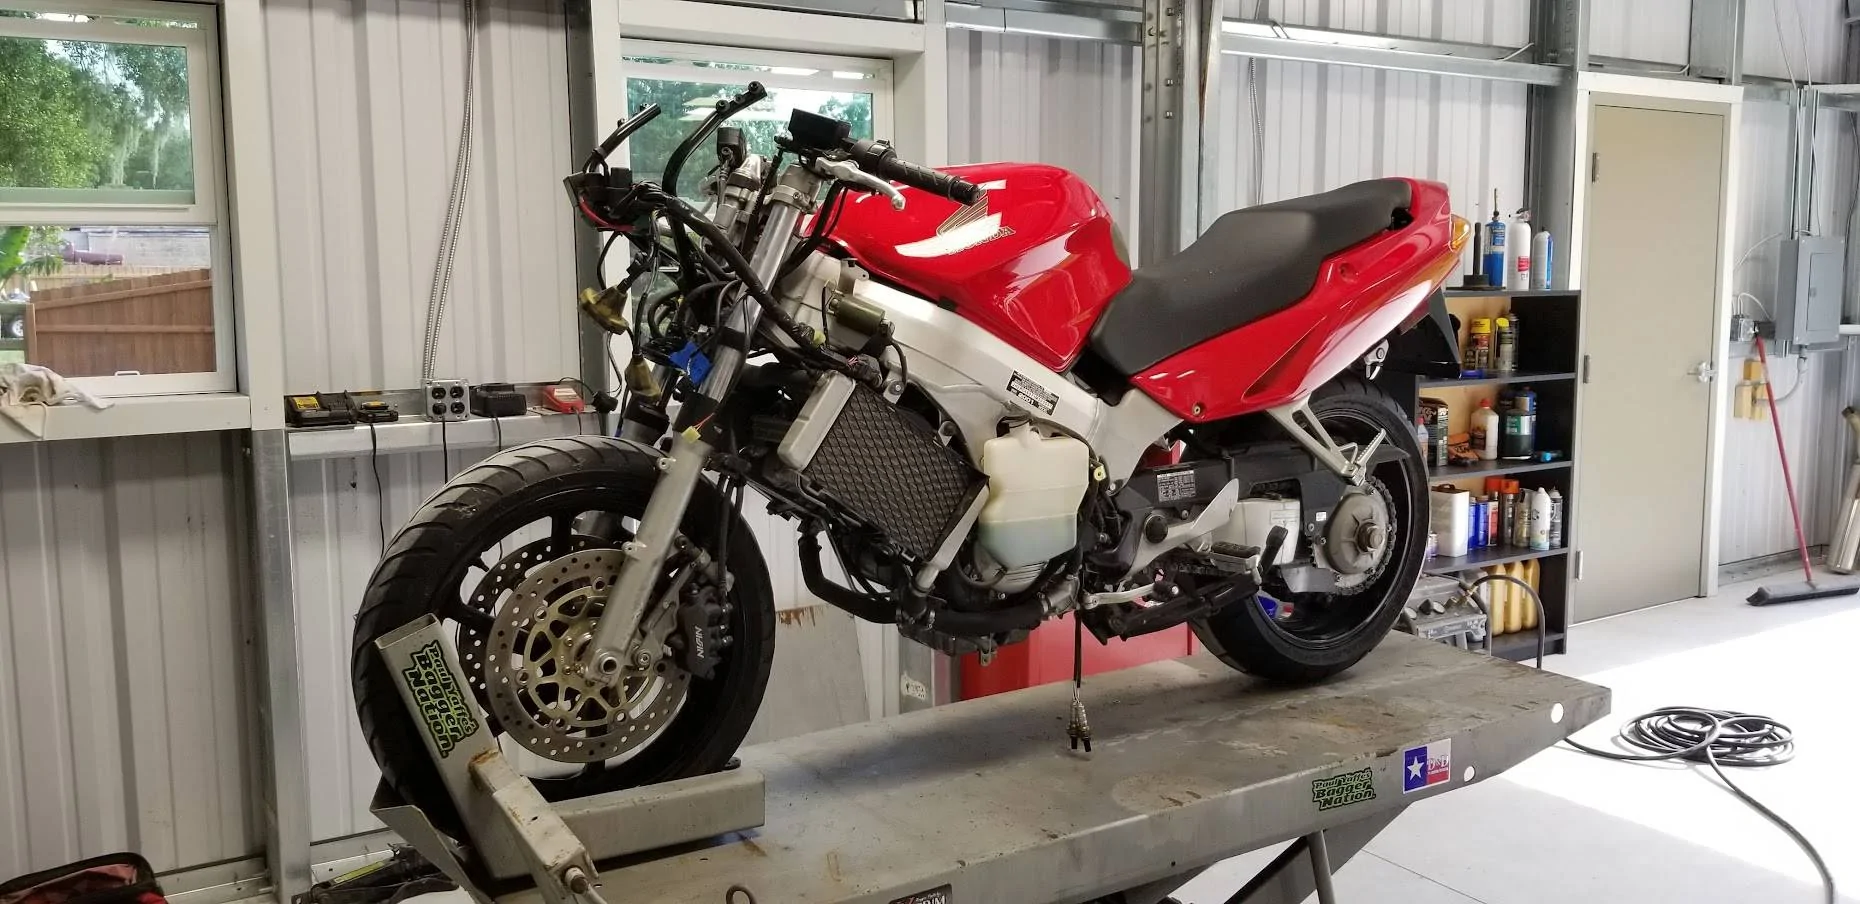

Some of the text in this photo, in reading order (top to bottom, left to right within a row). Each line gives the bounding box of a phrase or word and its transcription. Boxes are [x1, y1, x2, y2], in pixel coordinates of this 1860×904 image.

[414, 652, 464, 741] Bagger
[428, 644, 478, 735] Paul Yaffe's
[1314, 778, 1339, 790] Paul
[1315, 781, 1371, 799] Bagger
